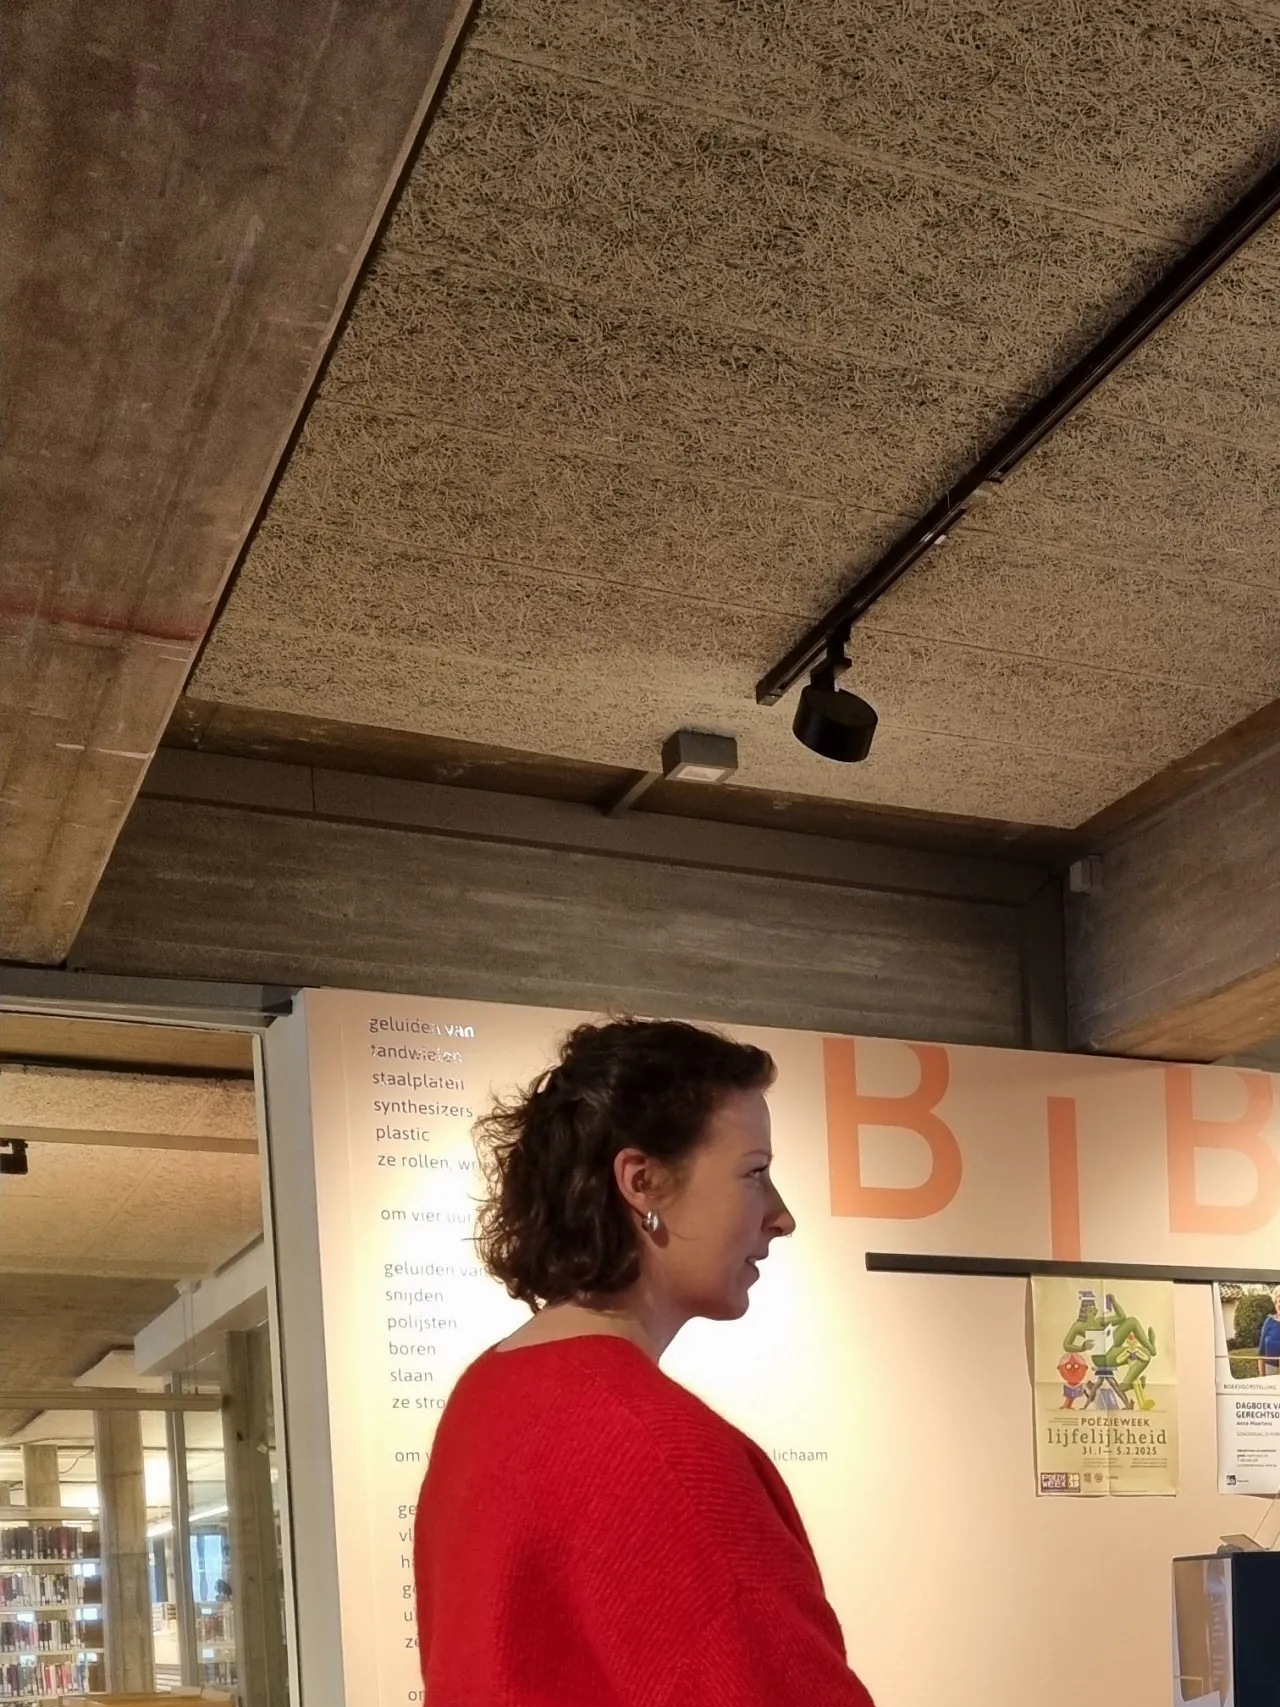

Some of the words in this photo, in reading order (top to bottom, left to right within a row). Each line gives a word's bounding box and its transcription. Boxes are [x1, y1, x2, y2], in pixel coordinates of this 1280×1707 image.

[369, 1016, 441, 1035] geluiden
[445, 1025, 475, 1038] van
[372, 1072, 465, 1090] staalplaten
[374, 1099, 474, 1117] synthesizers
[376, 1125, 431, 1141] plastic
[378, 1155, 396, 1166] ze
[402, 1155, 453, 1170] rollen,
[381, 1209, 406, 1220] om
[412, 1211, 441, 1222] vier
[447, 1214, 471, 1223] uur
[384, 1261, 454, 1278] geluiden
[385, 1289, 443, 1305] snijden
[387, 1316, 457, 1332] polijsten
[389, 1342, 436, 1355] boren
[390, 1368, 433, 1382] slaan
[392, 1398, 410, 1409] ze
[1236, 1402, 1271, 1410] DAGBOEK
[1081, 1417, 1150, 1427] POËZIEWEEK
[1047, 1428, 1167, 1447] lijfelijkheid
[395, 1451, 420, 1462] om
[1116, 1446, 1157, 1456] 5.2.2025
